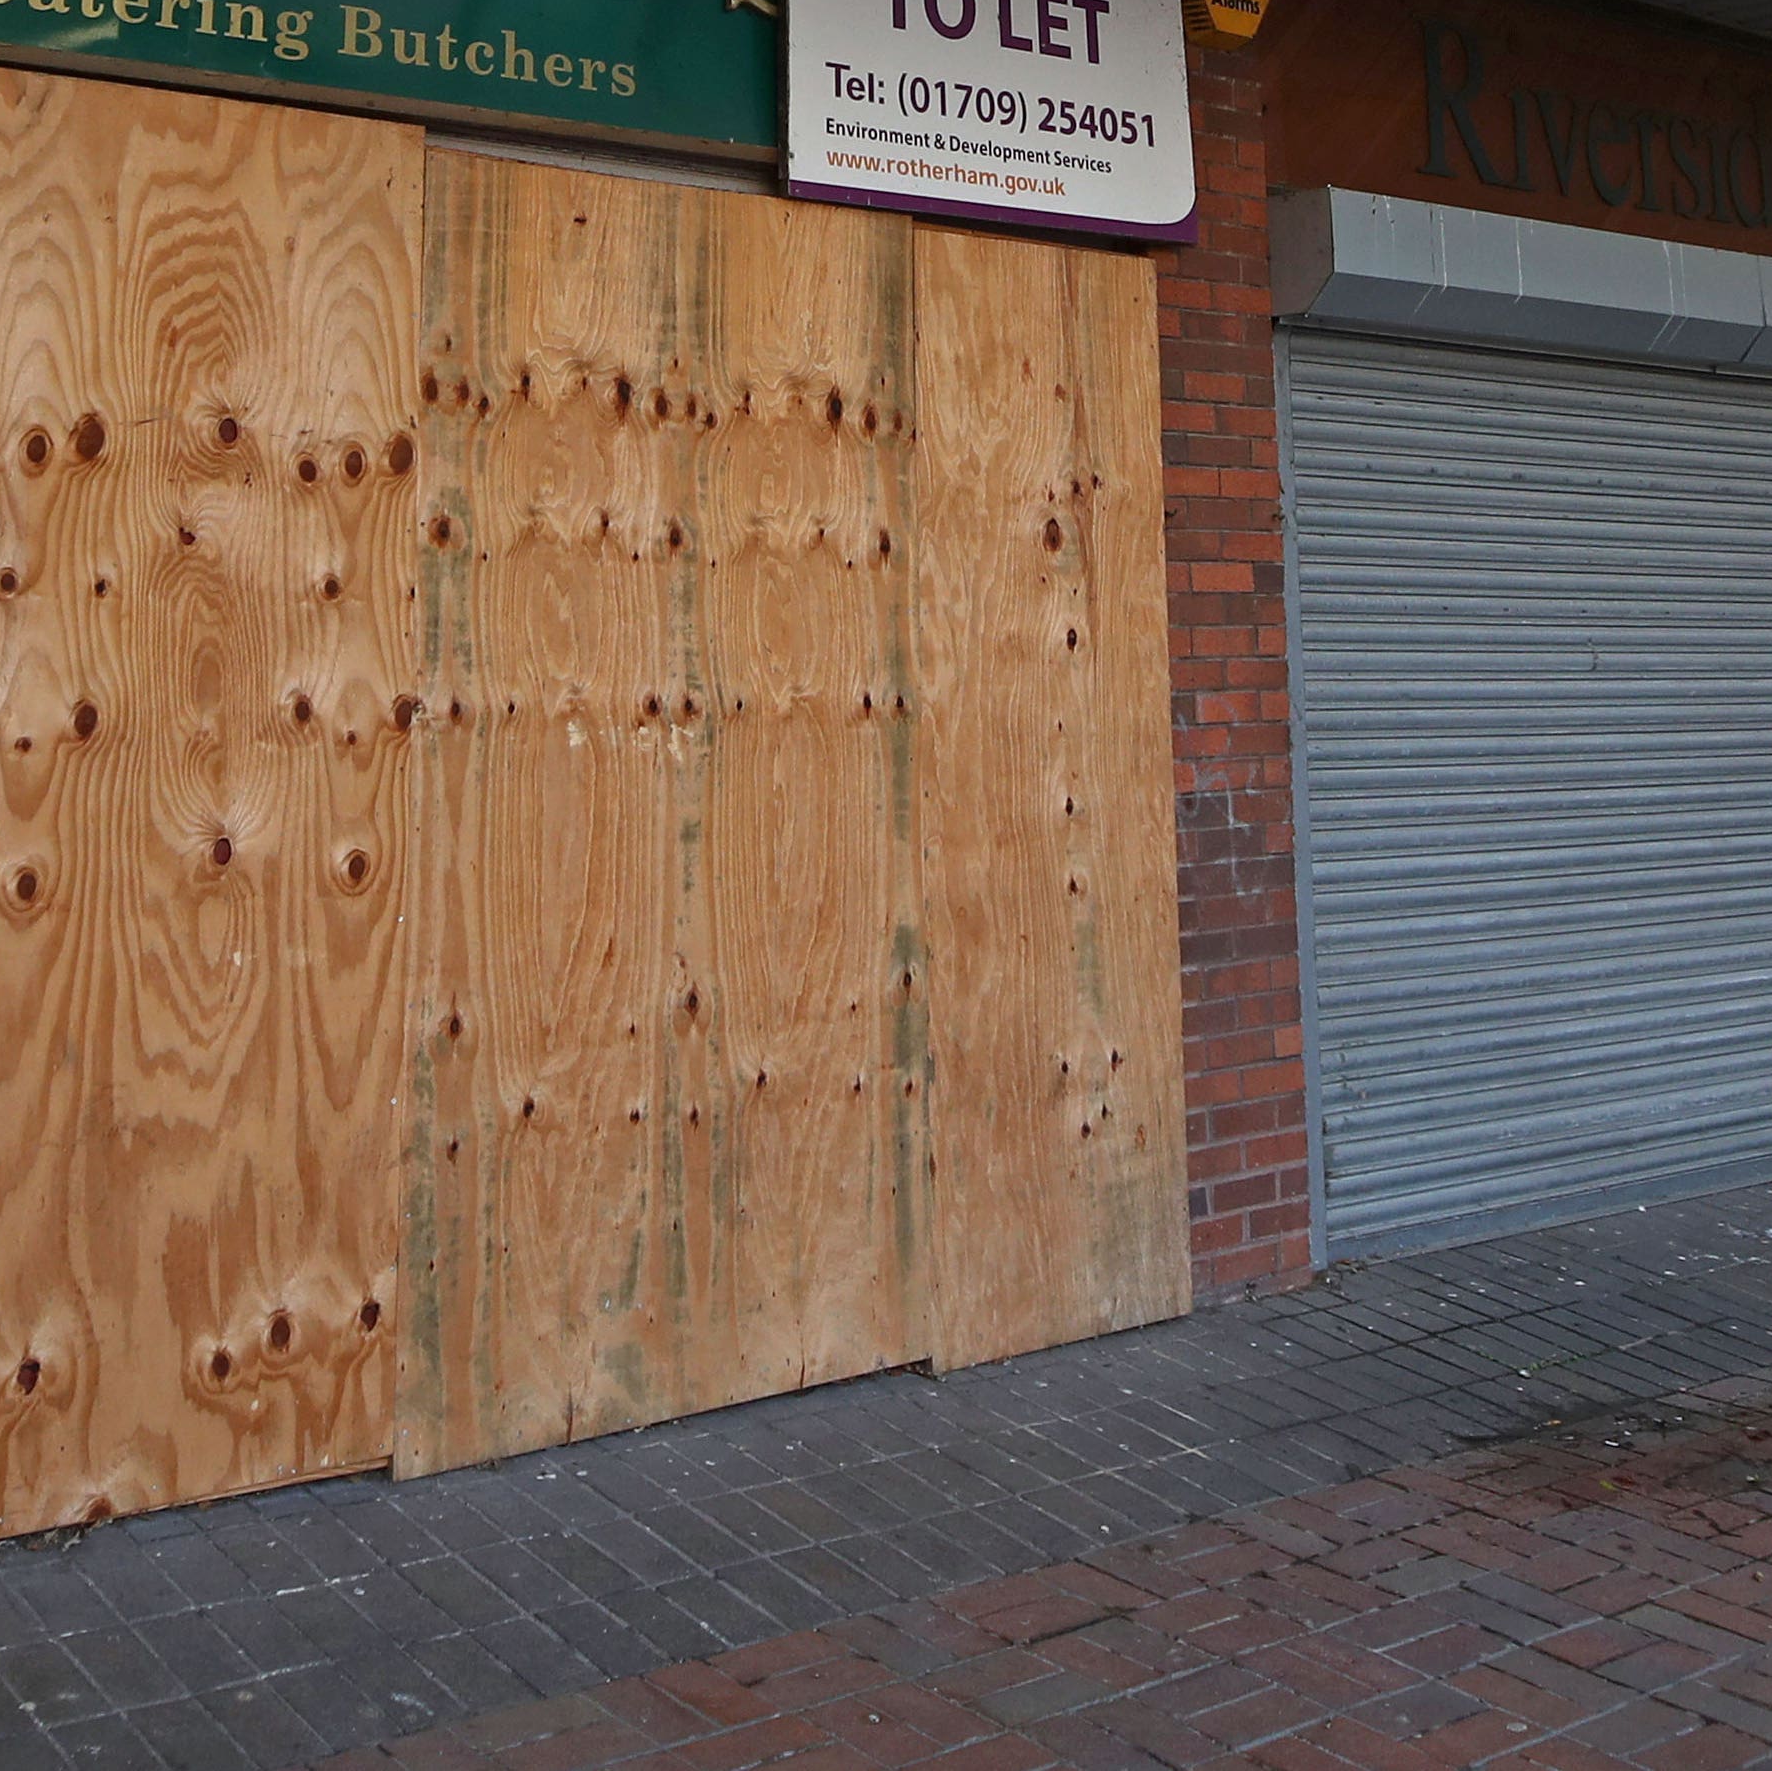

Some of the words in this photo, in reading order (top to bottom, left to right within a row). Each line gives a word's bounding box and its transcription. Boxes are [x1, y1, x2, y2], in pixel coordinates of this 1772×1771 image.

[336, 2, 638, 99] Butchers
[825, 61, 886, 105] Tel:
[898, 72, 1029, 134] (01709)
[1037, 97, 1156, 148] 254051
[826, 117, 931, 149] Environment
[933, 132, 946, 151] &
[949, 135, 1051, 166] Development
[1054, 149, 1112, 175] Services
[826, 149, 1067, 197] www.rotherham.gov.uk
